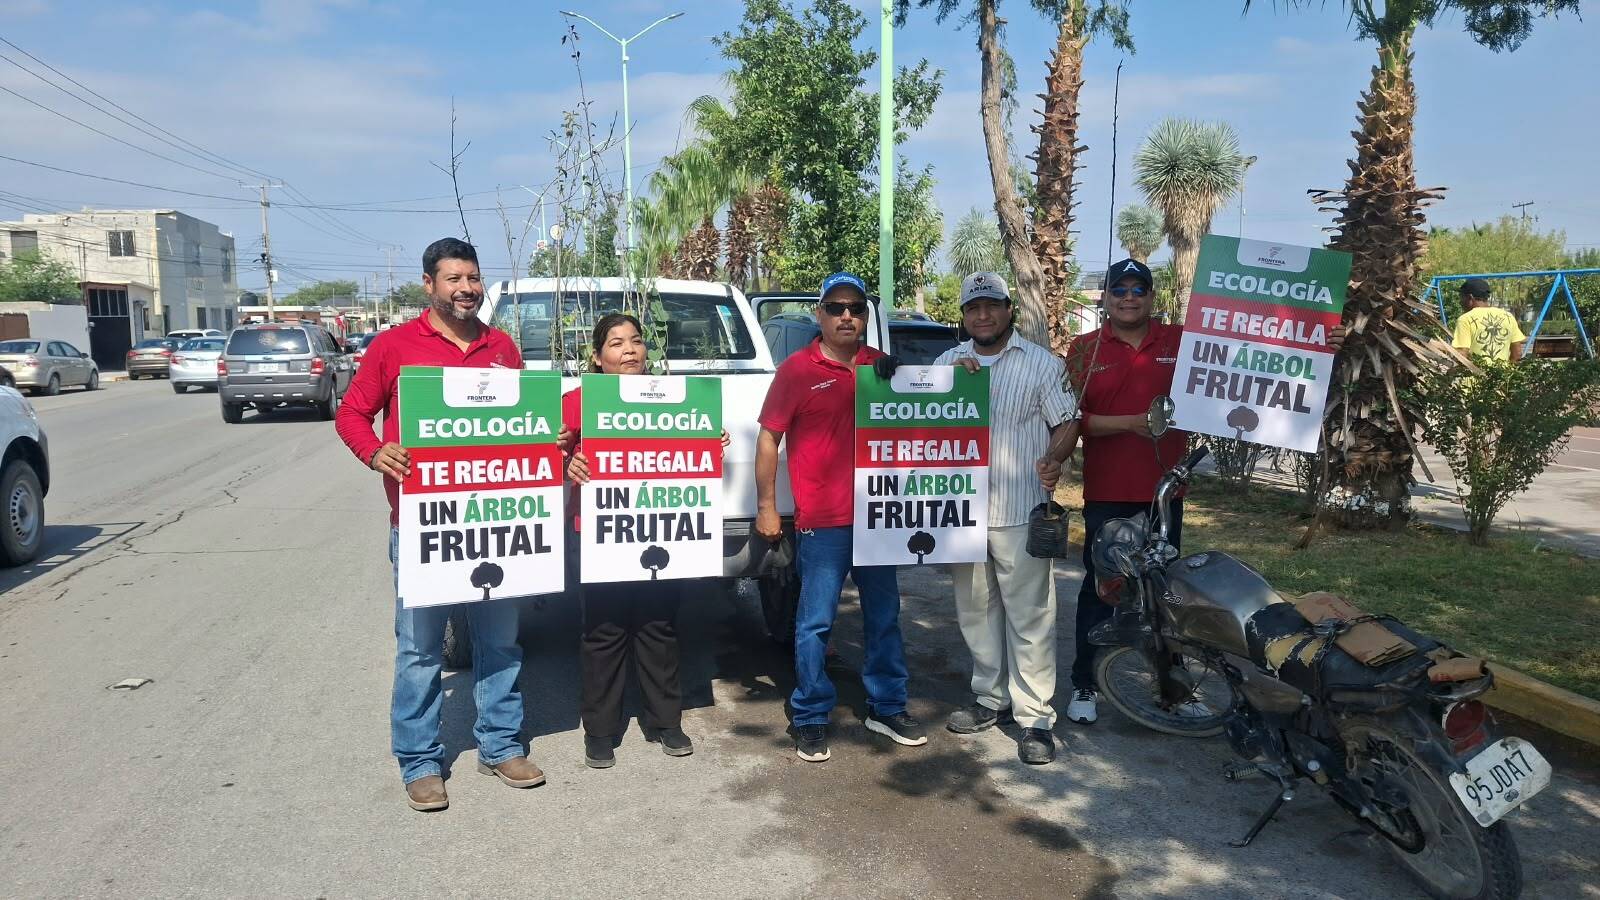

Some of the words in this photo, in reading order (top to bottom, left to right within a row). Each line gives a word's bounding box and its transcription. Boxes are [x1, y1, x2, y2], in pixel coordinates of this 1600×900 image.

[1123, 261, 1140, 272] A
[1258, 256, 1286, 265] FRONTERA
[969, 285, 993, 294] ARIAT
[1208, 270, 1333, 305] ECOLOGÍA
[1201, 306, 1229, 332] TE
[1231, 311, 1326, 346] REGALA
[1192, 340, 1229, 366] UN
[1231, 342, 1317, 380] ÁRBOL
[1185, 366, 1311, 414] FRUTAL
[597, 408, 713, 431] ECOLOGÍA
[869, 397, 980, 420] ECOLOGÍA
[418, 411, 551, 438] ECOLOGÍA
[595, 451, 624, 473] TE
[627, 450, 714, 472] REGALA
[867, 440, 893, 462] TE
[897, 439, 980, 461] REGALA
[417, 461, 449, 486] TE
[454, 456, 553, 484] REGALA
[867, 475, 899, 496] UN
[903, 469, 976, 496] ÁRBOL
[419, 500, 457, 526] UN
[463, 493, 551, 523] ÁRBOL
[596, 487, 629, 509] UN
[635, 481, 711, 508] ÁRBOL
[596, 512, 712, 544] FRUTAL
[867, 499, 977, 529] FRUTAL
[420, 523, 551, 564] FRUTAL
[1465, 749, 1533, 808] 95JDA7
